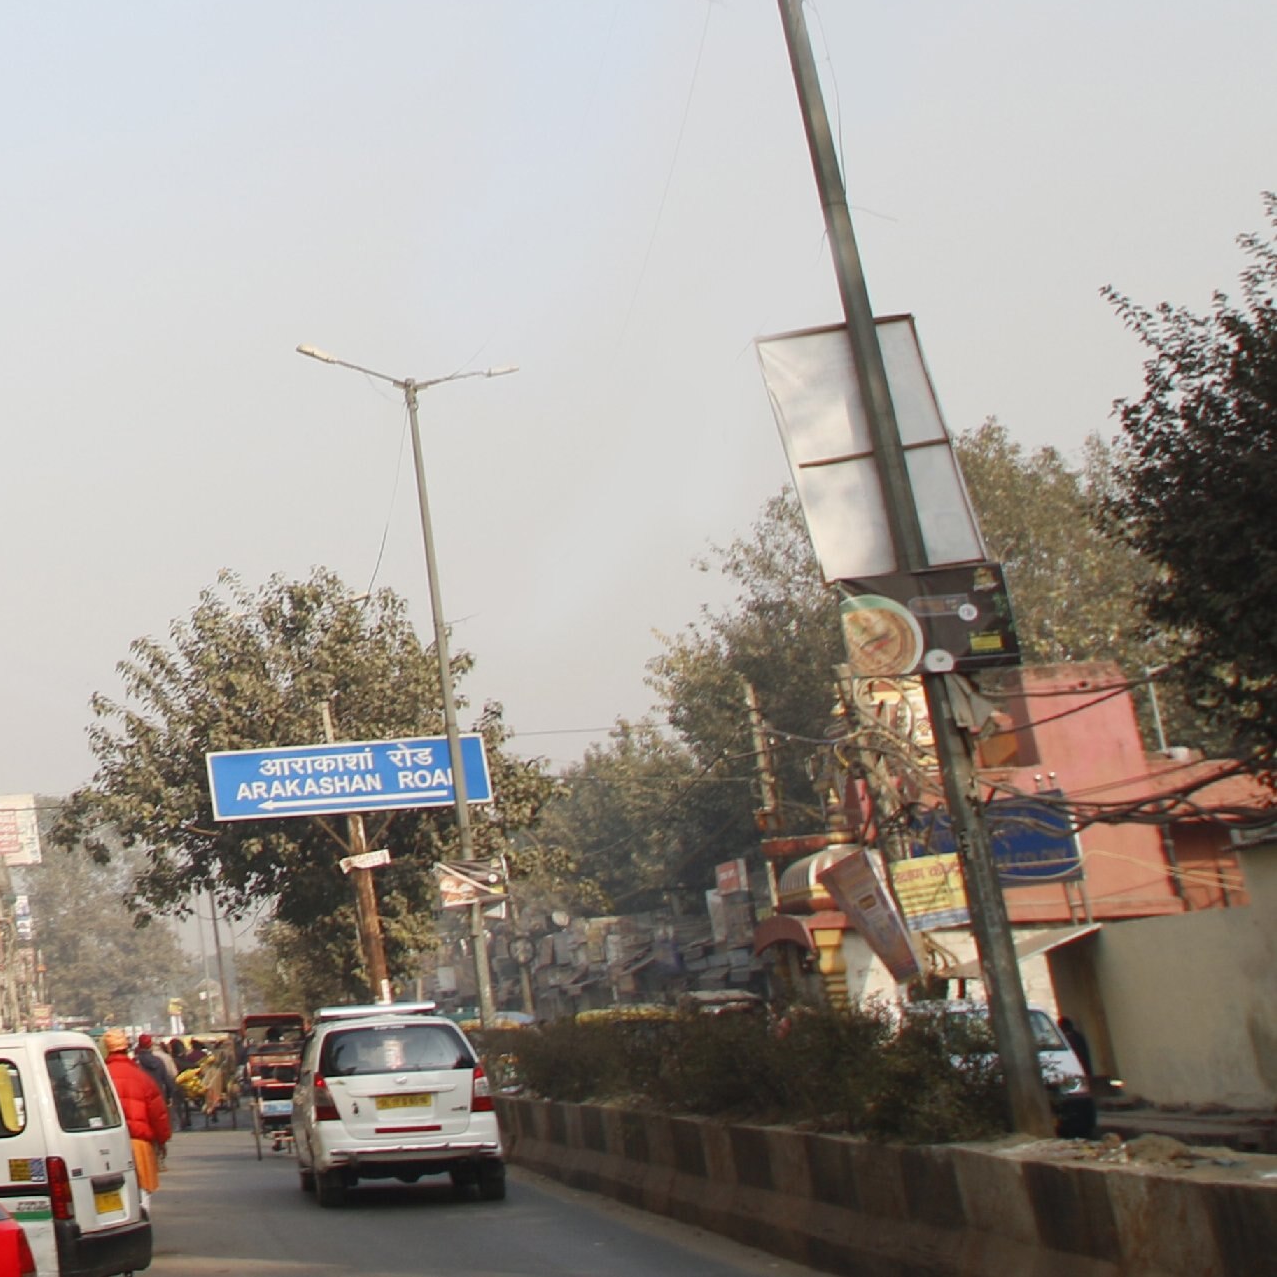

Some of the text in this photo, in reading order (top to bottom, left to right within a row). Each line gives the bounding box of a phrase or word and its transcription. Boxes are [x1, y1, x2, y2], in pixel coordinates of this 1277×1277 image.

[258, 743, 434, 777] आराकाशां रोड
[236, 773, 382, 801] ARAKASHAN
